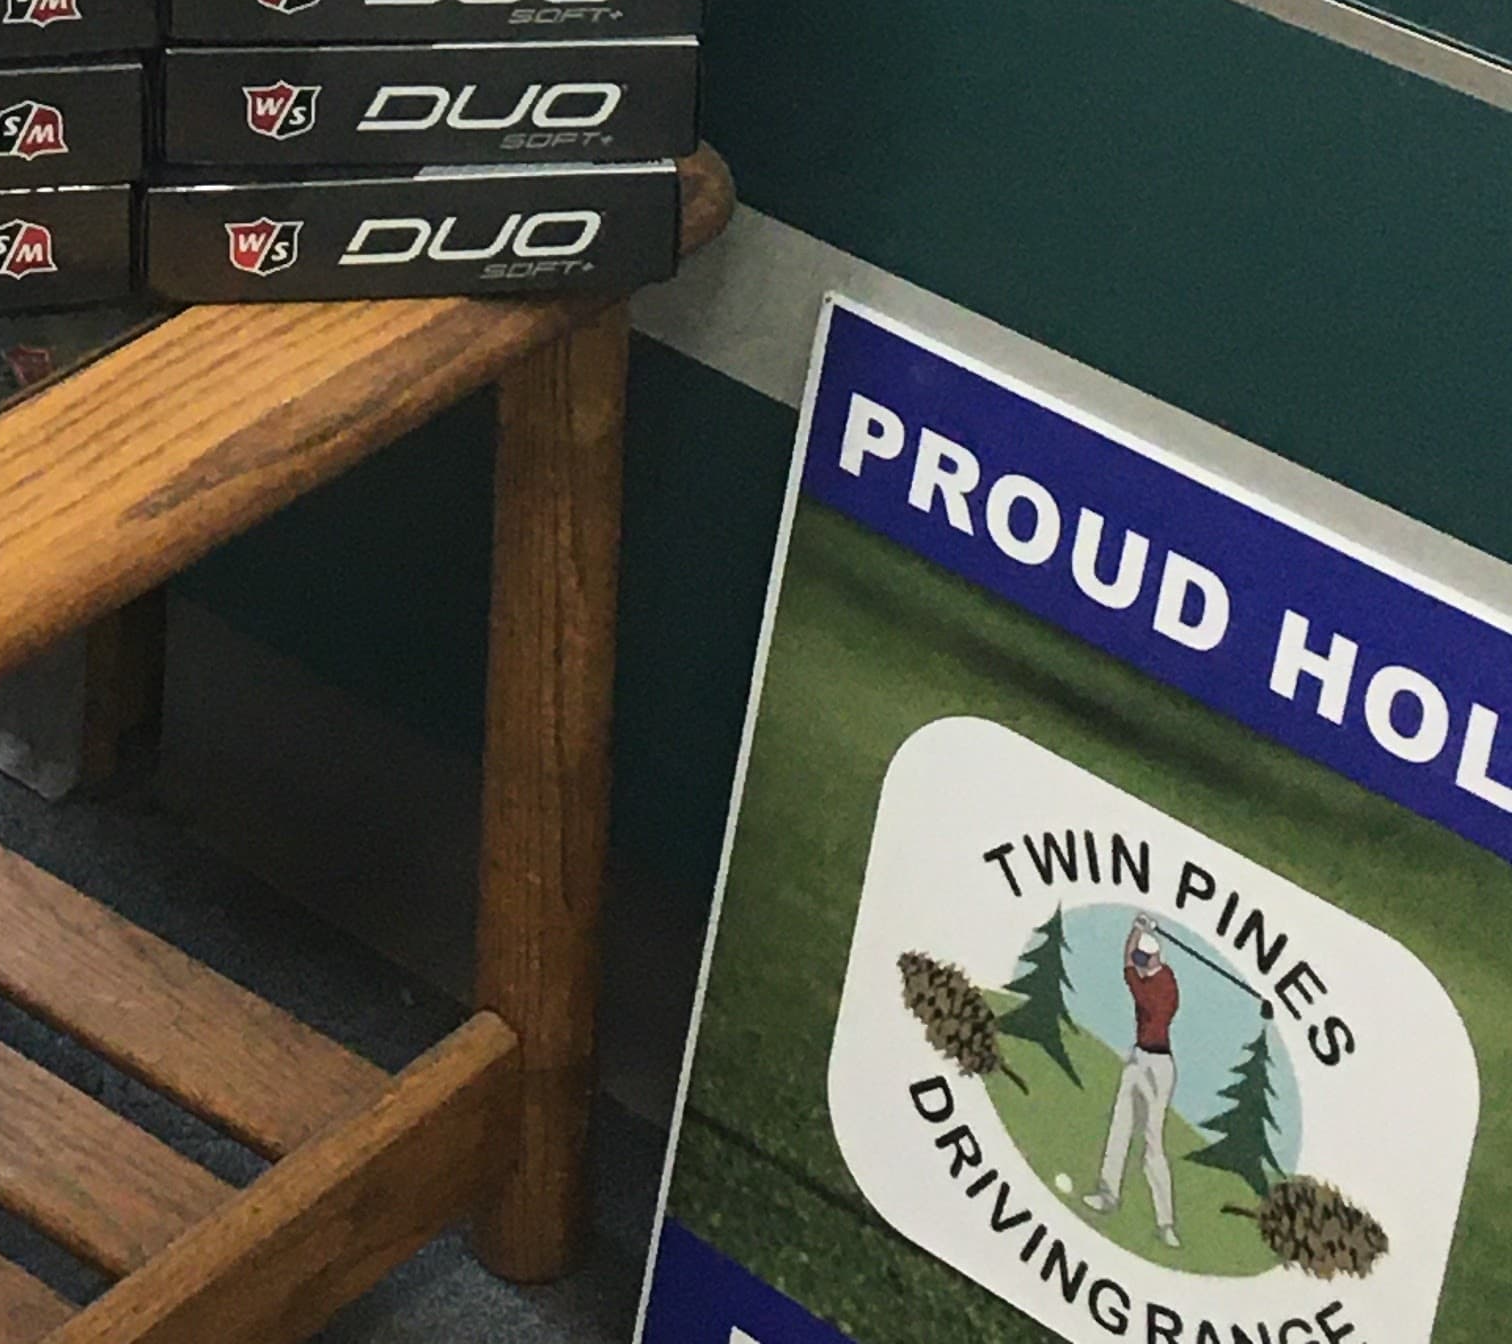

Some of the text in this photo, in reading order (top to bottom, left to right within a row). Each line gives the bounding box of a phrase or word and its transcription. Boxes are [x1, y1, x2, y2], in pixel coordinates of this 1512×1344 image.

[355, 81, 623, 132] DUO
[337, 209, 603, 266] DUO
[838, 391, 1512, 814] PROUD HOL
[982, 828, 1357, 1068] TWIN PINES
[908, 1074, 1132, 1337] DRIVING
